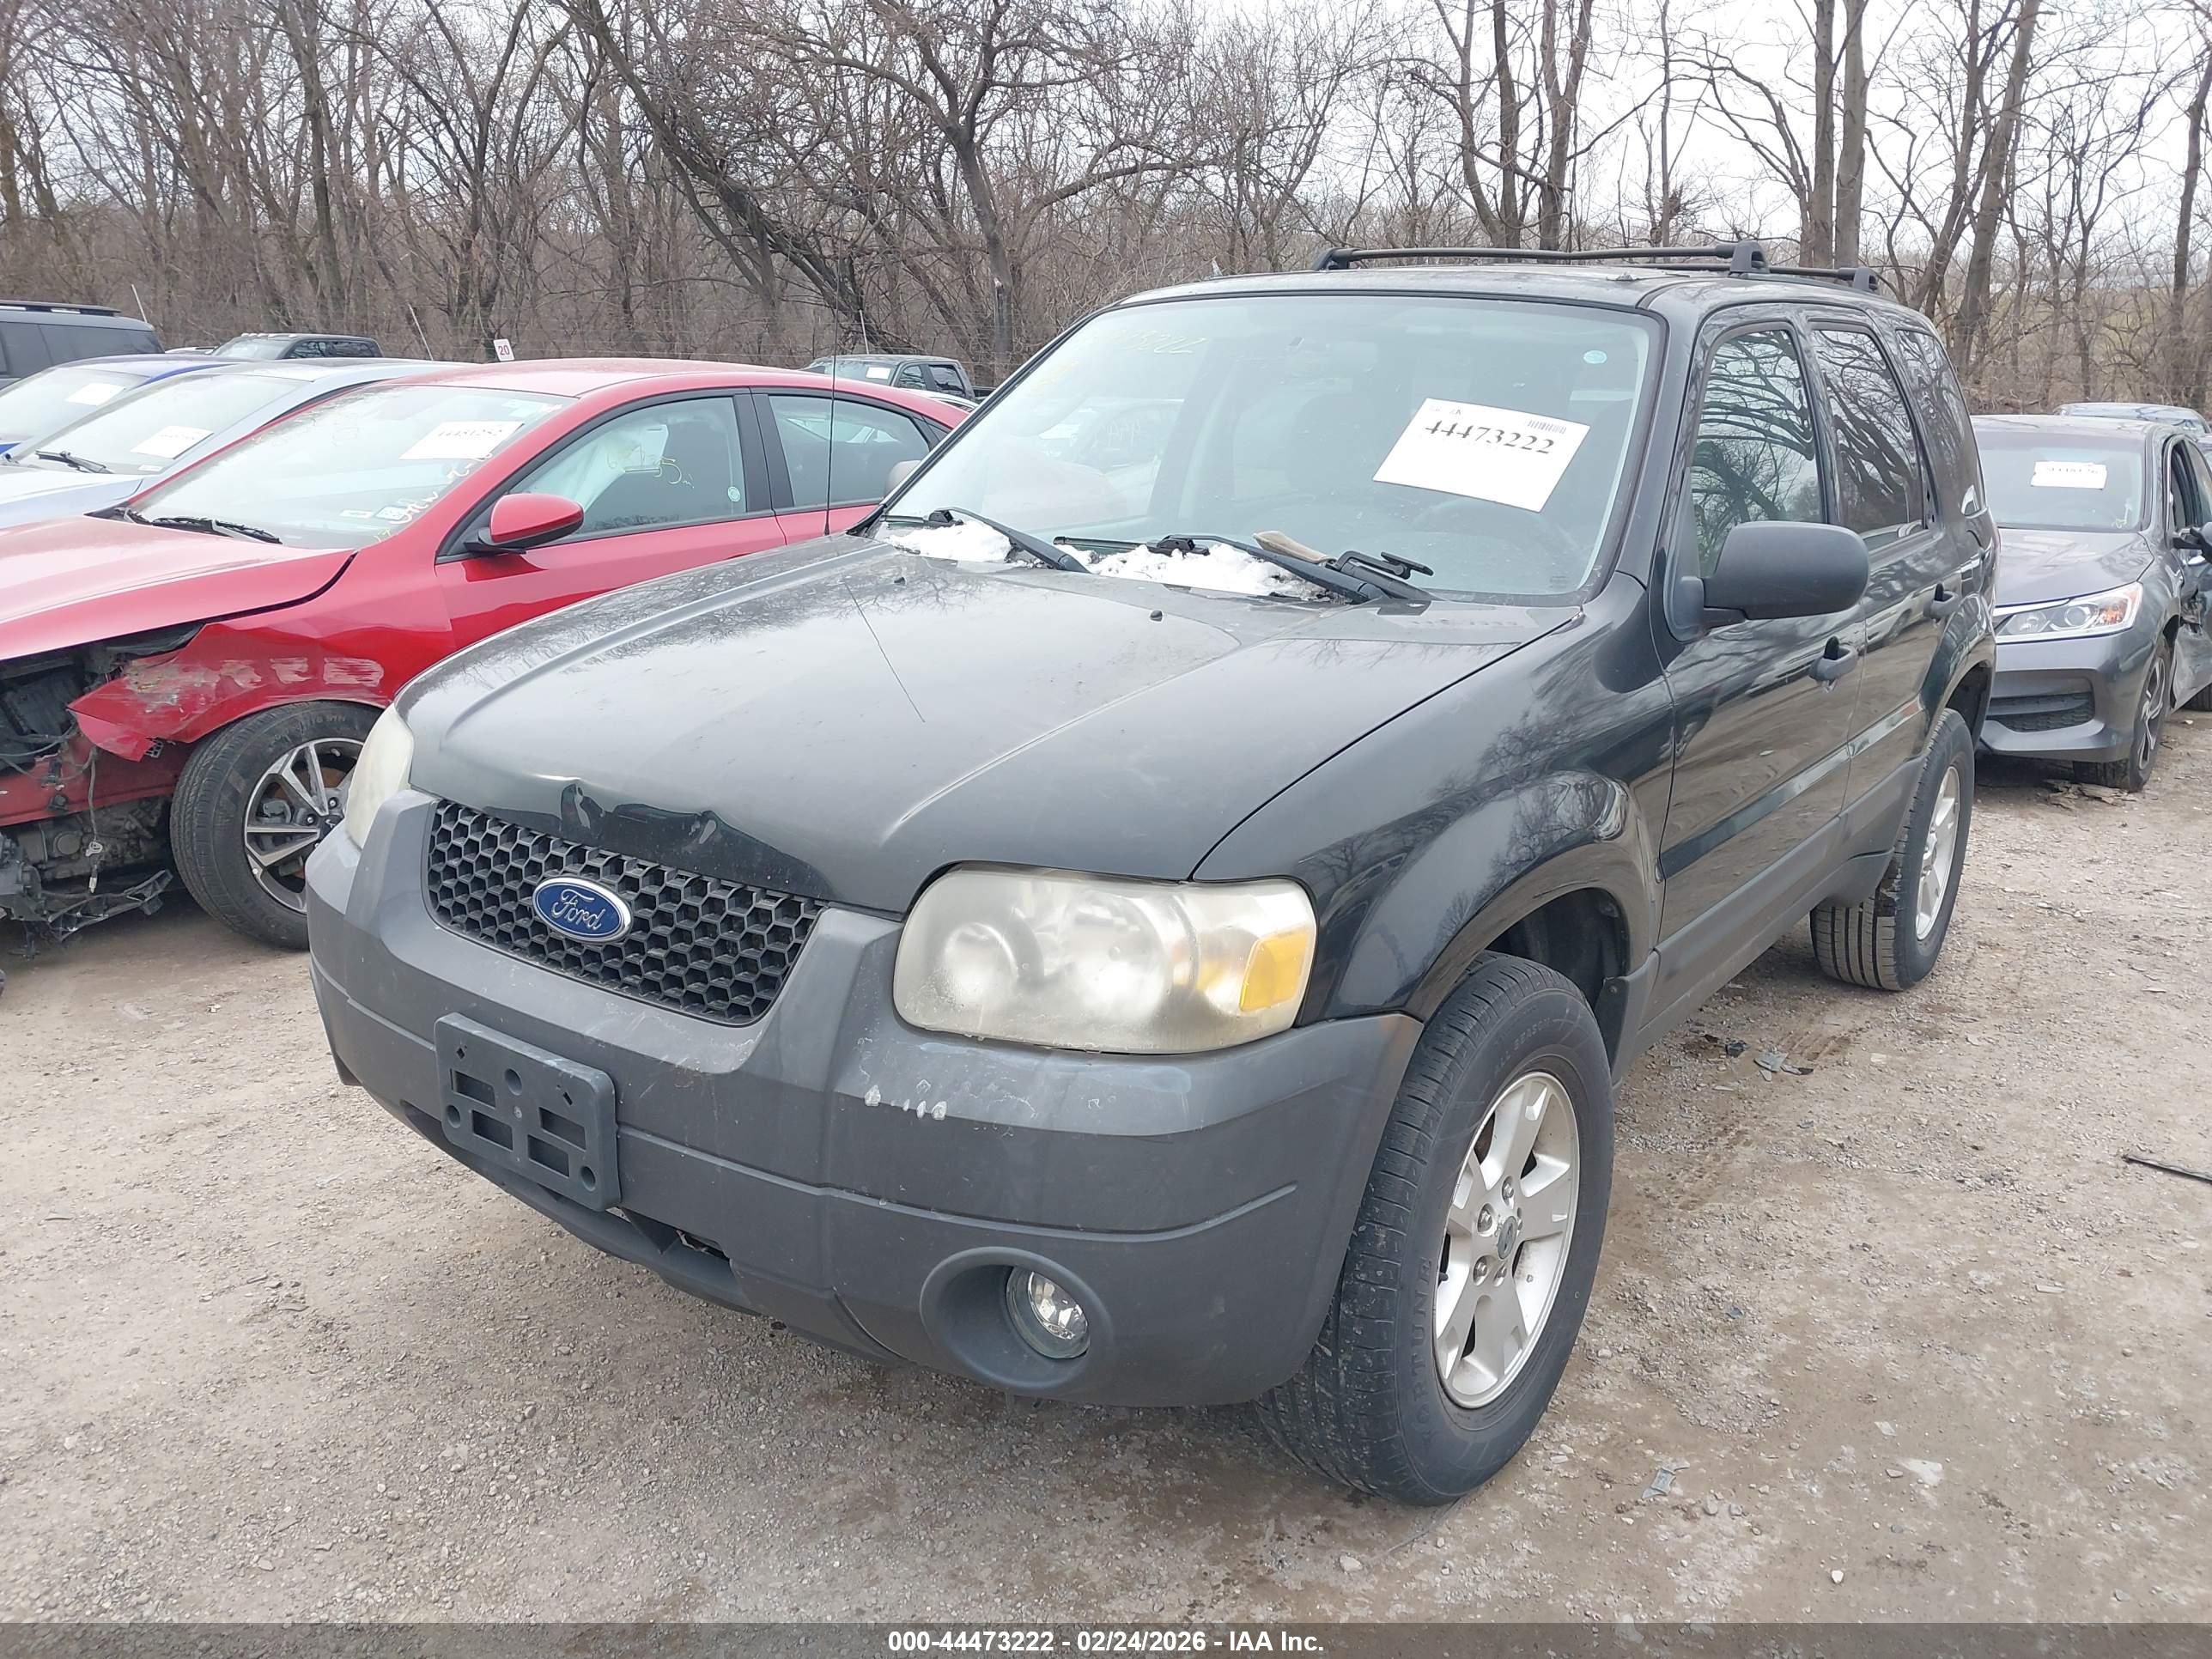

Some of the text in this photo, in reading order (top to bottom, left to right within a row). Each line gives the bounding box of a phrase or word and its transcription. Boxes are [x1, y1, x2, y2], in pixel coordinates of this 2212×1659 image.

[498, 345, 510, 356] 20
[1425, 420, 1555, 454] 44473222
[551, 889, 606, 931] Ford
